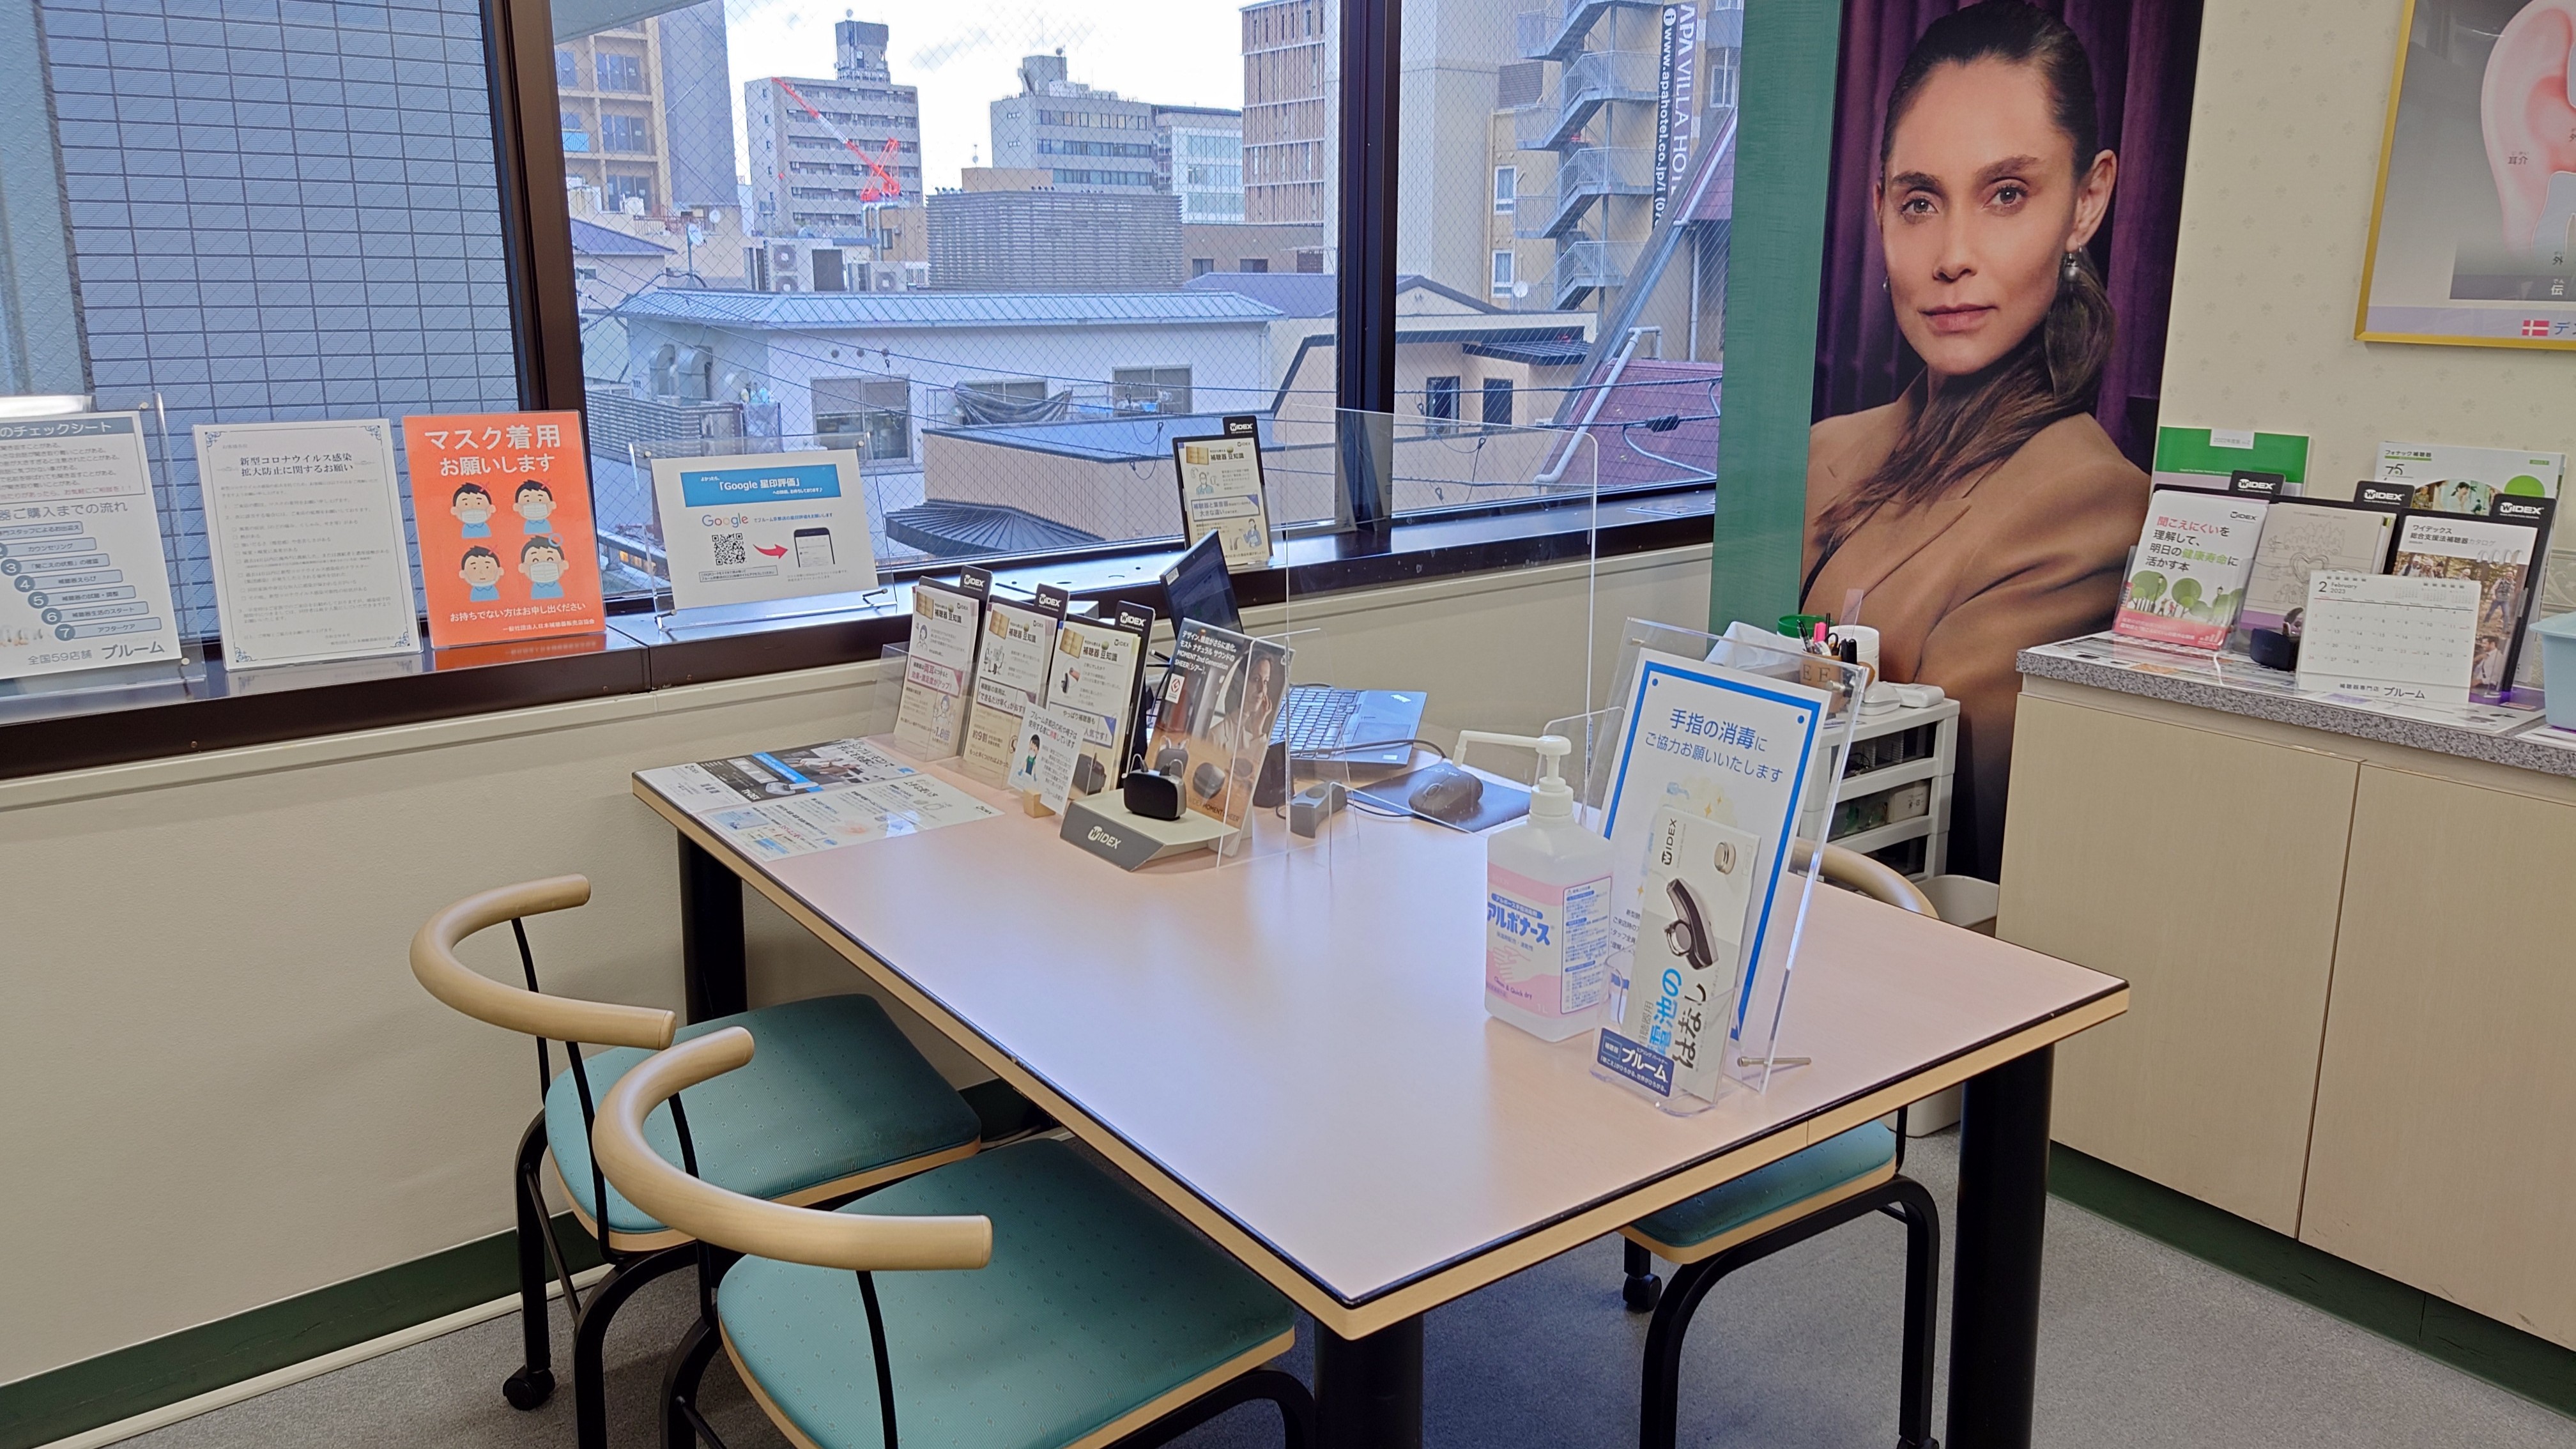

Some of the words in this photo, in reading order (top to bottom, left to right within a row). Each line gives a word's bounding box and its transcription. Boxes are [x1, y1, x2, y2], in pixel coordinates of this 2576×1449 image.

[1678, 4, 1695, 56] APA
[1675, 58, 1692, 128] VILLA
[1671, 135, 1688, 195] HO
[2508, 156, 2528, 165] 耳介
[0, 421, 112, 438] のチェックシート
[1230, 423, 1254, 431] WIDEX
[425, 424, 561, 450] マスク着用
[240, 452, 353, 466] 新型コロナウイルス感染
[440, 454, 555, 477] お願いします
[241, 464, 353, 477] 拡大防止に関するお願い
[2238, 479, 2274, 490] WIDEX
[2364, 489, 2404, 502] WIDEX
[2230, 511, 2257, 521] WIDEX
[2500, 502, 2542, 515] WIDEX
[702, 512, 749, 528] Google
[2157, 516, 2230, 537] 聞こえにくいを
[2153, 529, 2200, 546] 理解して、
[2412, 525, 2453, 535] ワイデックス
[28, 543, 73, 553] カウンセリング
[2150, 542, 2239, 567] 明日の健康寿命に
[6, 563, 17, 573] 3
[2145, 556, 2190, 572] 活かす本
[20, 579, 30, 590] 4
[963, 574, 985, 587] WIDEX
[2318, 581, 2327, 593] 2
[2331, 581, 2358, 590] February
[33, 595, 44, 606] 5
[1039, 593, 1061, 608] WIDEX
[47, 612, 57, 622] 6
[450, 602, 586, 623] お持ちでない方はお申し出ください
[1120, 611, 1146, 627] WIDEX
[59, 627, 70, 638] 7
[98, 624, 135, 633] アフターケア
[28, 650, 93, 665] 全国59店舗
[102, 641, 165, 659] ブルーム
[1180, 640, 1192, 649] モスト
[1192, 643, 1213, 656] ナチュラル
[1213, 649, 1236, 663] サウンドの
[1177, 649, 1197, 661] MOMENT
[1205, 657, 1229, 671] Generation
[2340, 683, 2380, 692] 補聴器専門店
[2383, 687, 2426, 700] ブルーム
[1063, 710, 1095, 724] やっぱり補聴器も
[1669, 708, 1768, 753] 手指の消毒に
[1645, 731, 1783, 783] ご協力お願いいたします
[1087, 825, 1122, 850] WIDEX
[1661, 818, 1677, 866] WIDEX
[1487, 901, 1551, 946] アルボナース
[1610, 928, 1636, 944] タッフ全員
[1510, 986, 1524, 997] Quick
[1524, 990, 1533, 1000] dry
[1672, 983, 1707, 1070] はなし
[1621, 1047, 1667, 1082] ブルーム
